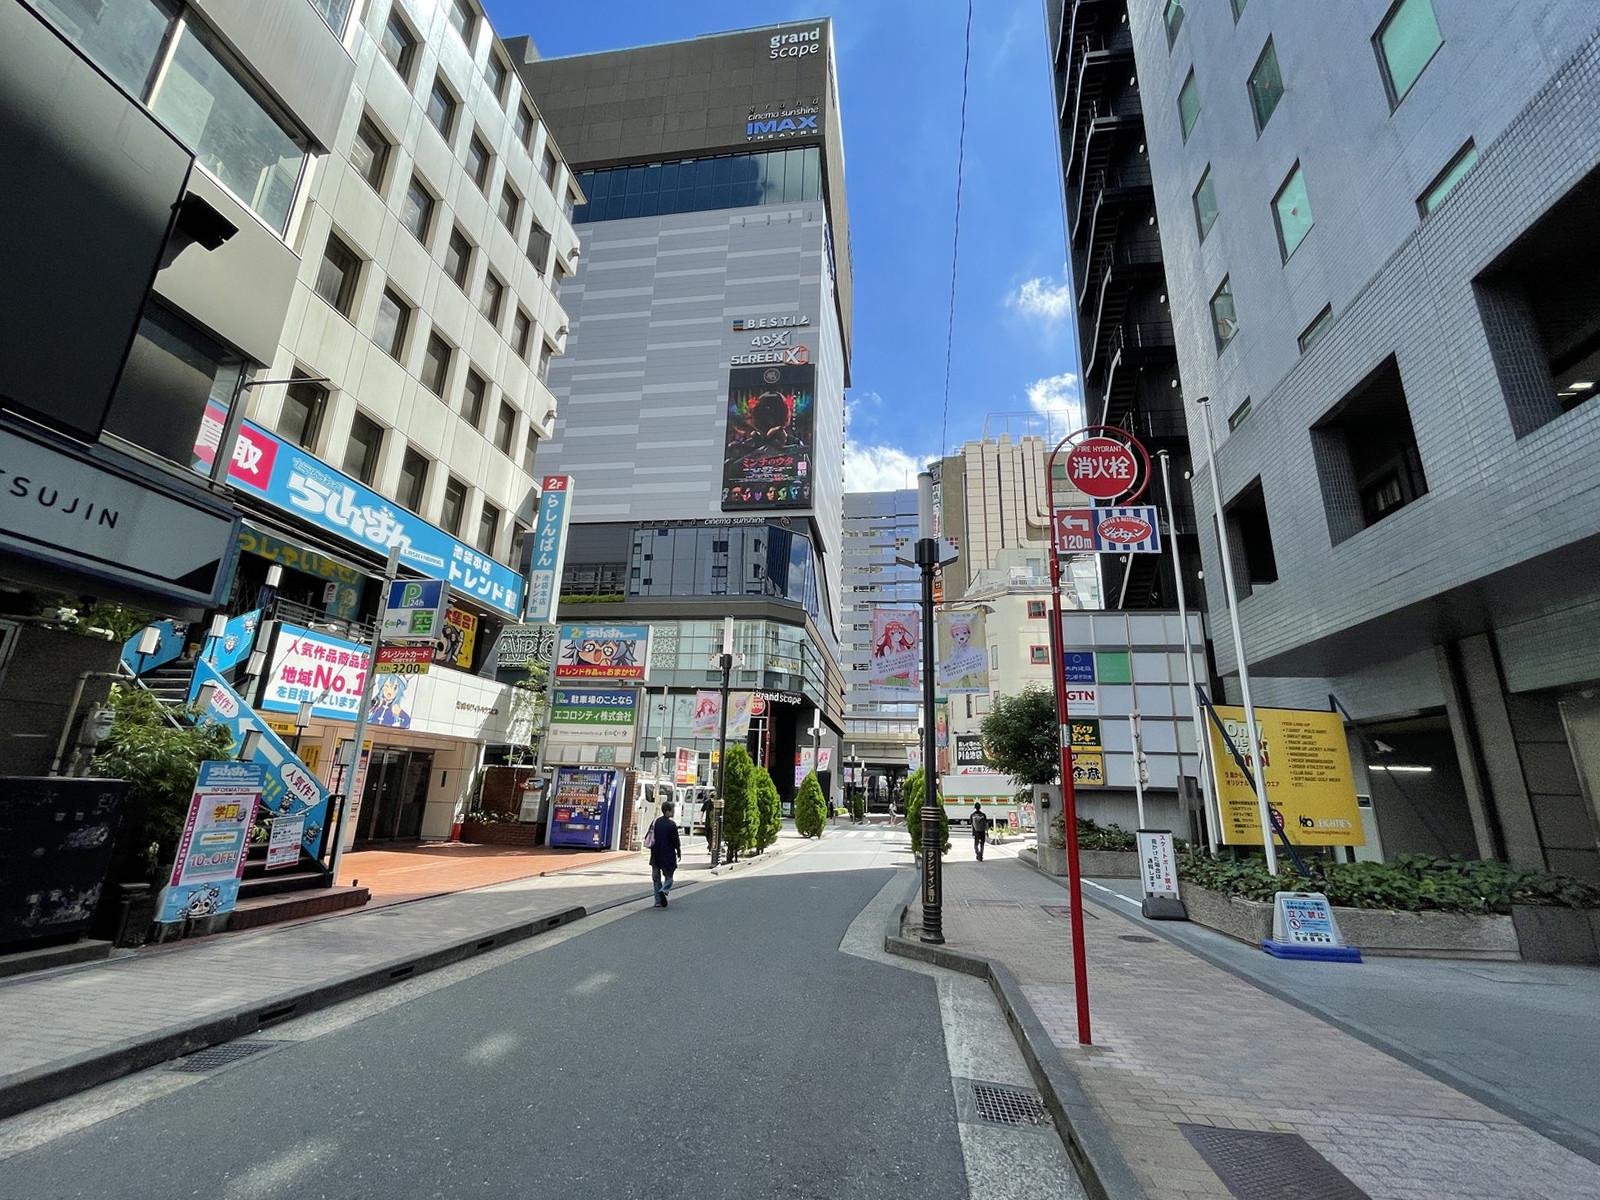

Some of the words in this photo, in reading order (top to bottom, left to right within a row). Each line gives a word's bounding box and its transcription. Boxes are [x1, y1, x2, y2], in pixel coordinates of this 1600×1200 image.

[770, 27, 820, 49] grand
[769, 43, 820, 60] scape
[748, 111, 779, 121] cinema
[781, 106, 819, 117] sunshine
[749, 97, 819, 113] grand
[746, 115, 818, 135] IMAX
[747, 129, 818, 141] THEATRE
[747, 314, 809, 328] BESTIA
[751, 330, 791, 347] 4DX
[731, 346, 800, 365] SCREENX
[231, 433, 263, 475] 取
[1076, 445, 1090, 453] FIRE
[1092, 445, 1122, 453] HYDRANT
[1073, 456, 1131, 479] 消火栓
[548, 478, 564, 490] 2F
[0, 469, 119, 529] SUJIN
[287, 471, 412, 551] らしんばん
[704, 517, 731, 525] cinema
[733, 516, 765, 524] sunshine
[537, 494, 559, 566] らしんばん
[1062, 535, 1093, 549] 120m
[453, 544, 492, 575] 池袋本店
[448, 560, 517, 610] トレンド館
[530, 574, 541, 614] トレンド館
[539, 574, 550, 606] 池袋本店
[401, 583, 423, 608] P
[411, 611, 434, 634] 空
[570, 627, 584, 638] 2F
[381, 650, 429, 659] クレジットカード
[212, 688, 234, 713] 題作!
[570, 694, 633, 705] 駐車場のことなら
[1066, 690, 1095, 701] GTN
[554, 710, 632, 722] エコロシティ株式会社
[1072, 724, 1093, 734] びっくり
[1072, 733, 1096, 742] ドンキー
[285, 770, 316, 800] 人気作!
[1151, 838, 1162, 880] 見かけた場合は
[1160, 834, 1172, 891] スケートボード禁止
[1288, 910, 1326, 919] 立入禁止
